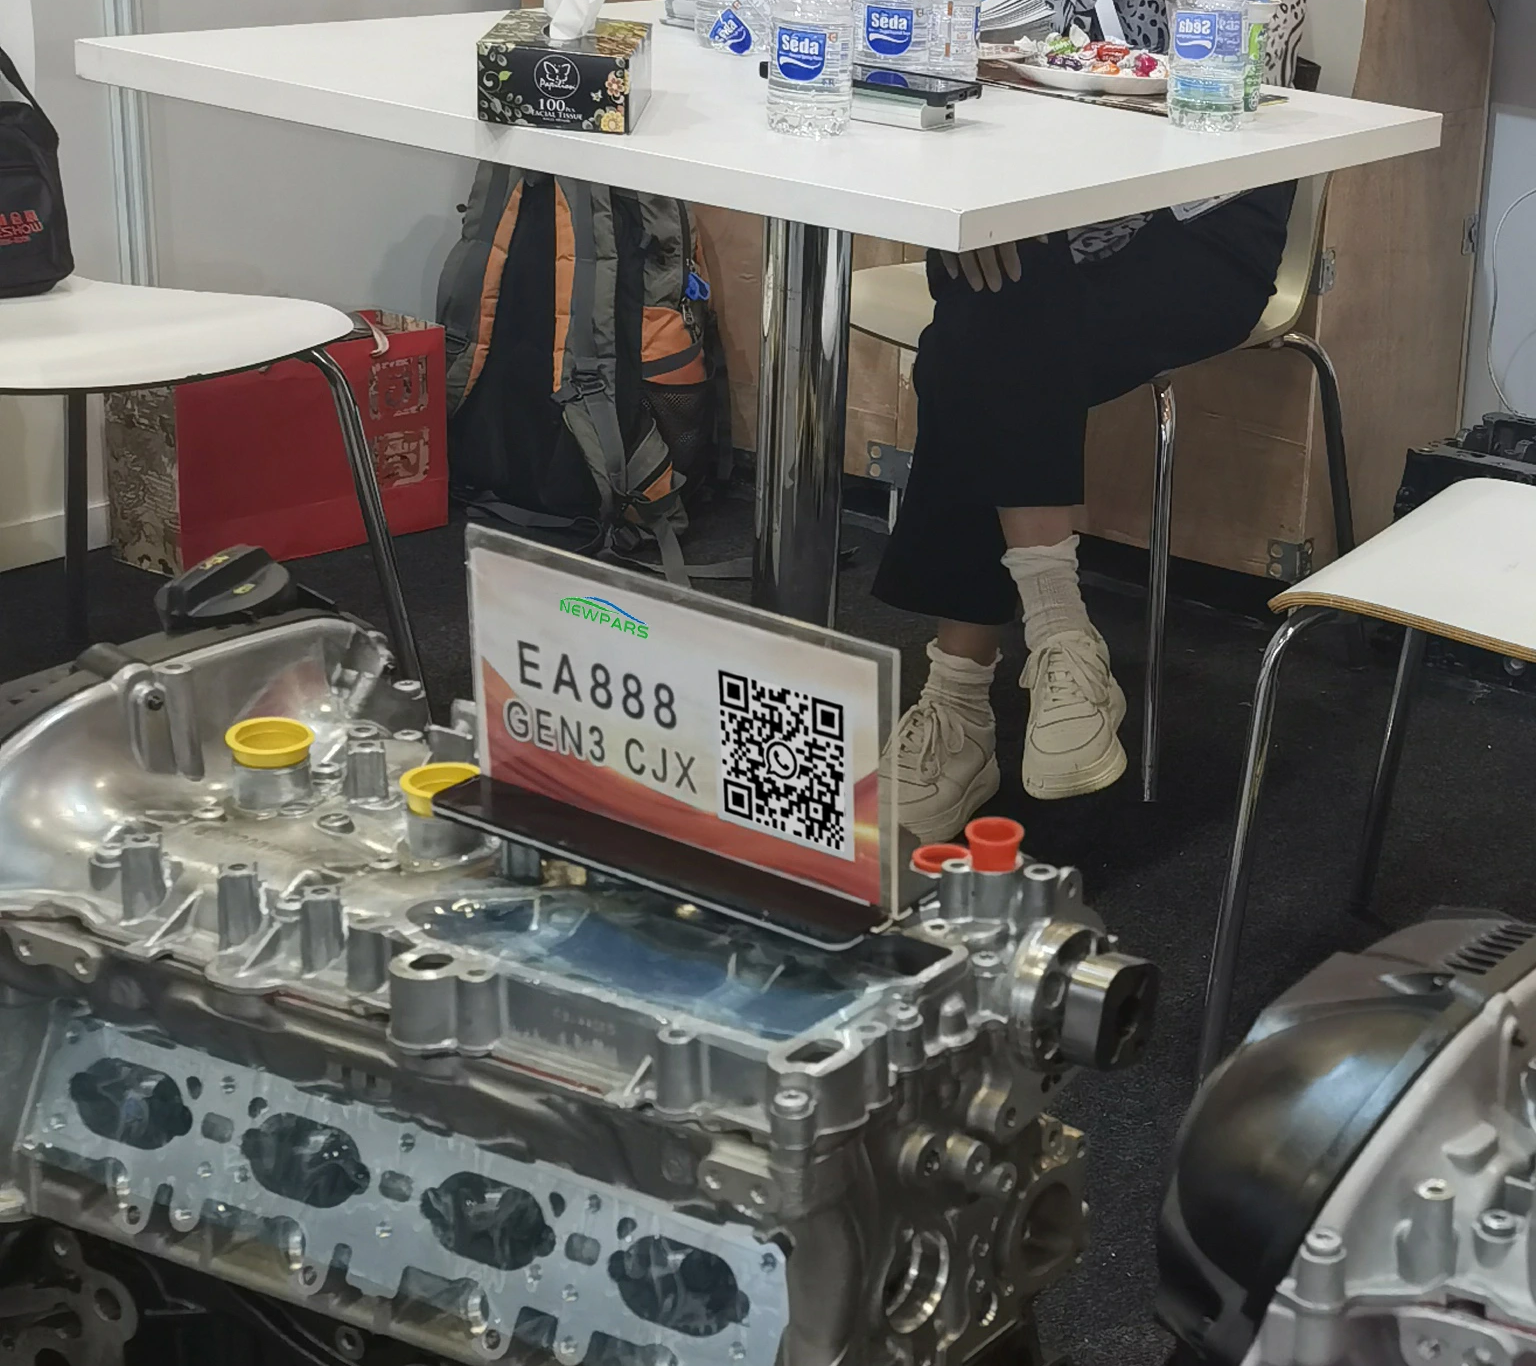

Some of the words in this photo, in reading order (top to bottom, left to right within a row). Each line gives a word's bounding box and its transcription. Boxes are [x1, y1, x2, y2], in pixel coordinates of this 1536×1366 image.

[539, 98, 566, 112] 100
[0, 221, 44, 237] SHOW
[559, 600, 649, 639] NEWPARS
[516, 639, 678, 731] EA888
[505, 700, 606, 764] GEN3
[624, 737, 698, 795] CJX
